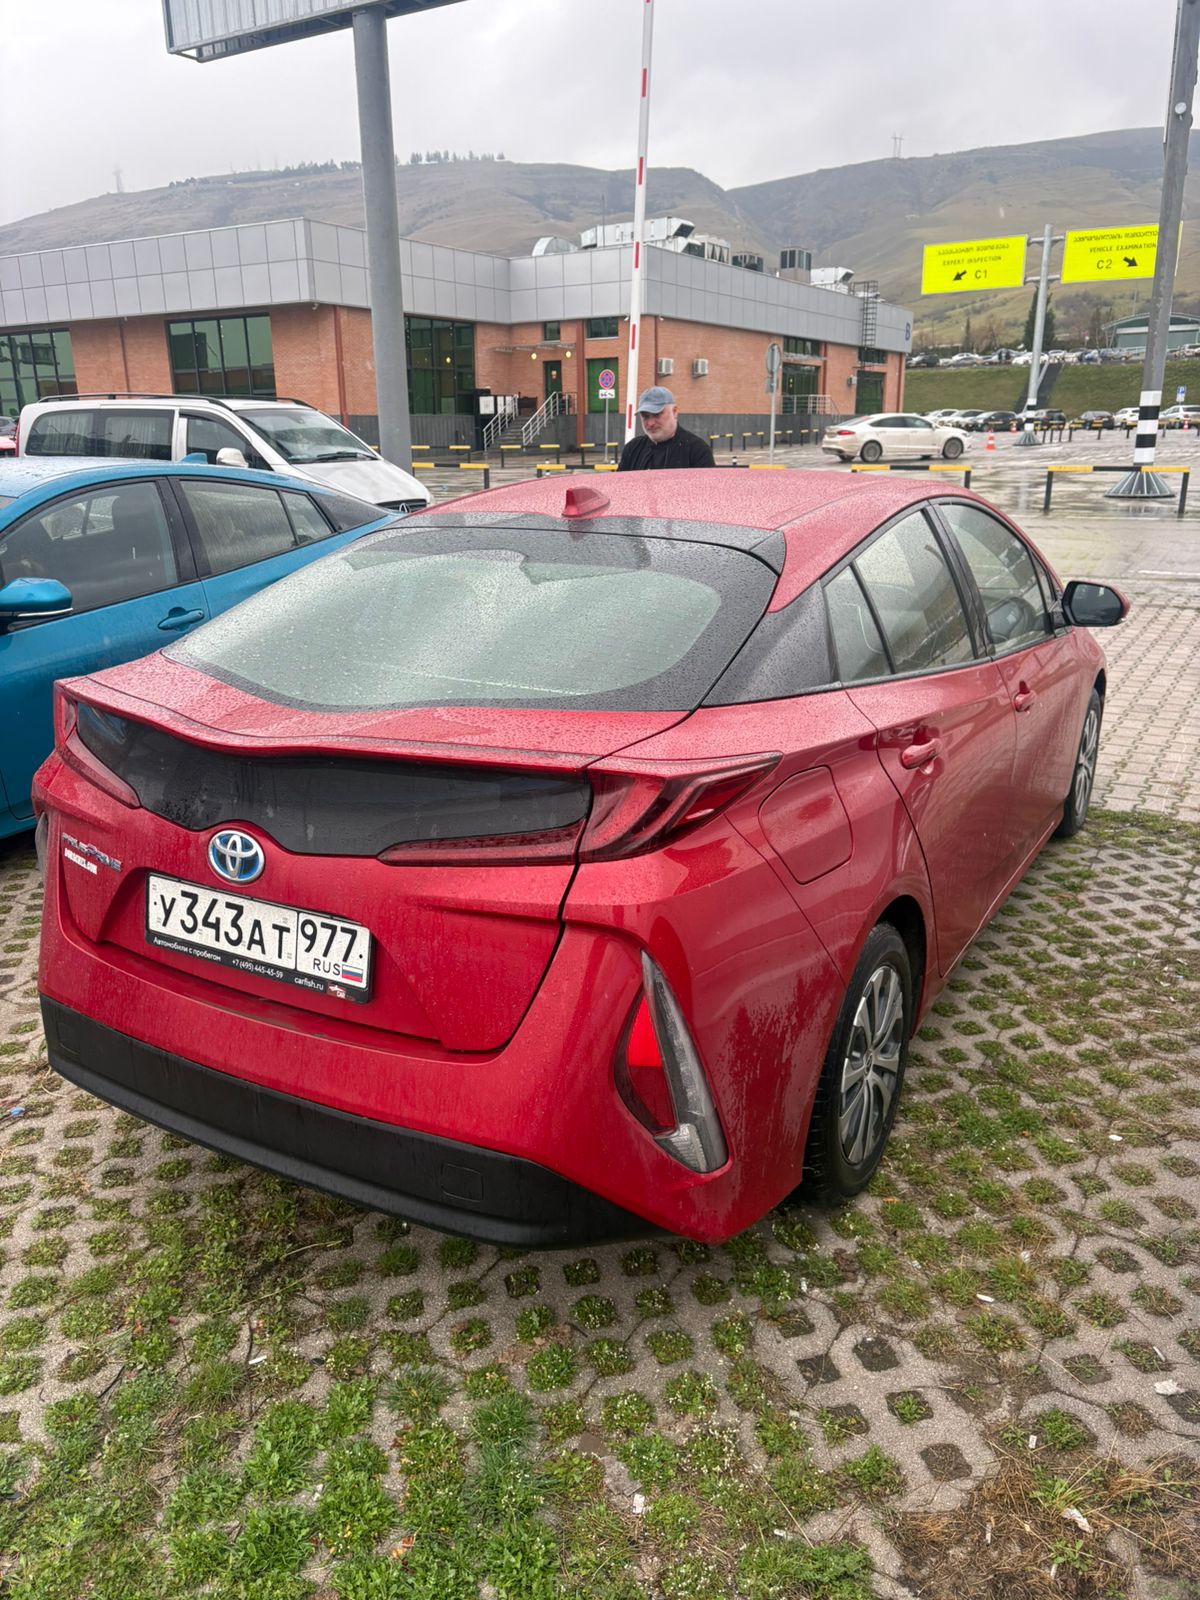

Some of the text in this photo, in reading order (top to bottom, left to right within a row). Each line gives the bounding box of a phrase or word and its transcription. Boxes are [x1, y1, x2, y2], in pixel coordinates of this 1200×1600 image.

[1116, 242, 1157, 251] EXAMINATION
[1096, 259, 1113, 270] C2
[974, 269, 988, 279] C1
[300, 919, 358, 962] 977
[153, 936, 188, 953] Автомобили
[192, 949, 222, 962] пробегом
[232, 958, 239, 967] +7
[239, 961, 254, 972] (495)
[313, 958, 341, 976] RUS
[294, 976, 324, 991] carfish.ru
